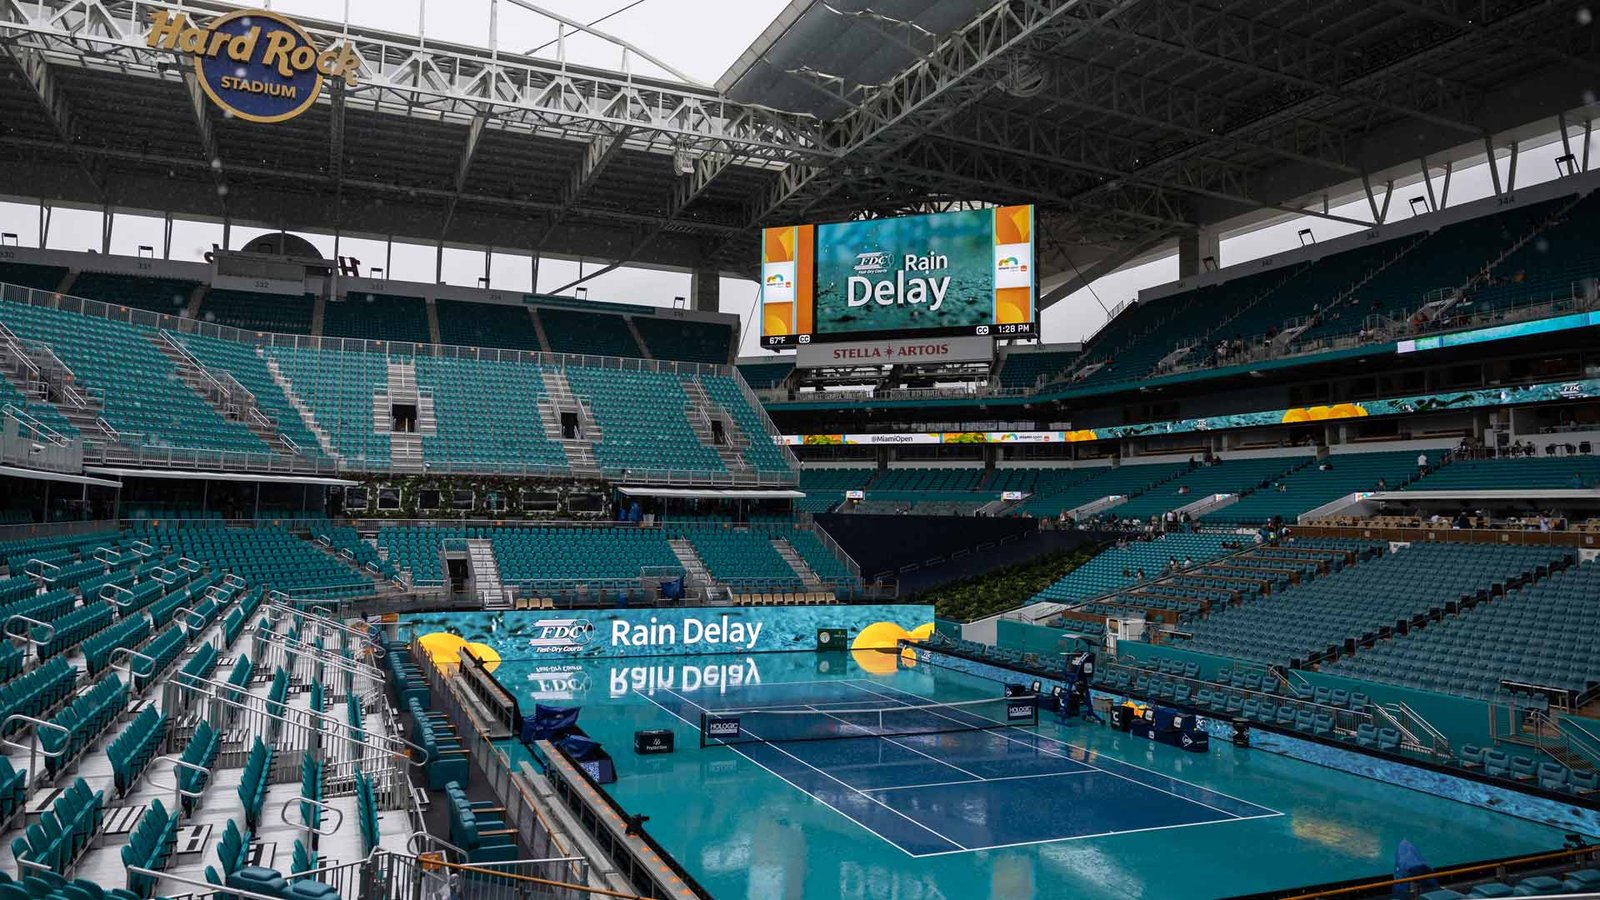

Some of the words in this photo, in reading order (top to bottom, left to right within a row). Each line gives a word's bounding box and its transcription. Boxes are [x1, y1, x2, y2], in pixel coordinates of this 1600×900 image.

[147, 10, 261, 61] Hard
[262, 30, 360, 87] Rock
[221, 75, 297, 98] STADIUM
[859, 255, 889, 265] FDC
[905, 251, 948, 271] Rain
[847, 270, 951, 311] Delay
[998, 325, 1015, 333] 1:28
[1017, 324, 1030, 333] PM
[832, 347, 881, 359] STELLA
[897, 344, 949, 356] ARTOIS
[871, 435, 913, 443] @MiamiOpen
[540, 625, 585, 639] FDC
[612, 616, 676, 647] Rain
[683, 615, 763, 649] Delay
[1009, 705, 1032, 713] HOLOGIC
[710, 722, 738, 730] HOLOGIC
